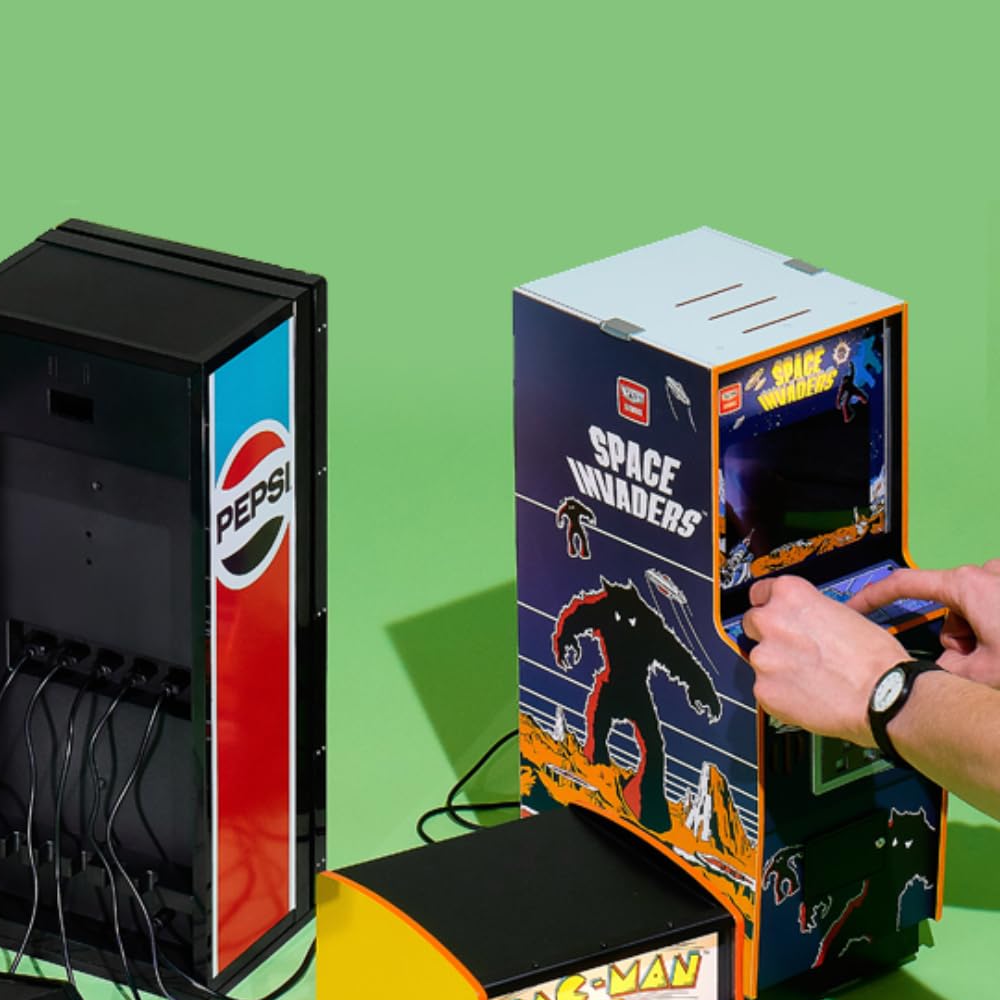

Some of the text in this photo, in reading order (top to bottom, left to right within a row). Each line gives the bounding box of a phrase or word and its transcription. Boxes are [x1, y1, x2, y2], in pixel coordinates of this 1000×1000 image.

[757, 368, 838, 412] INVADERS
[771, 346, 825, 387] SPACE
[588, 425, 682, 495] SPACE
[216, 461, 291, 545] PEPSI
[566, 456, 703, 538] INVADERS
